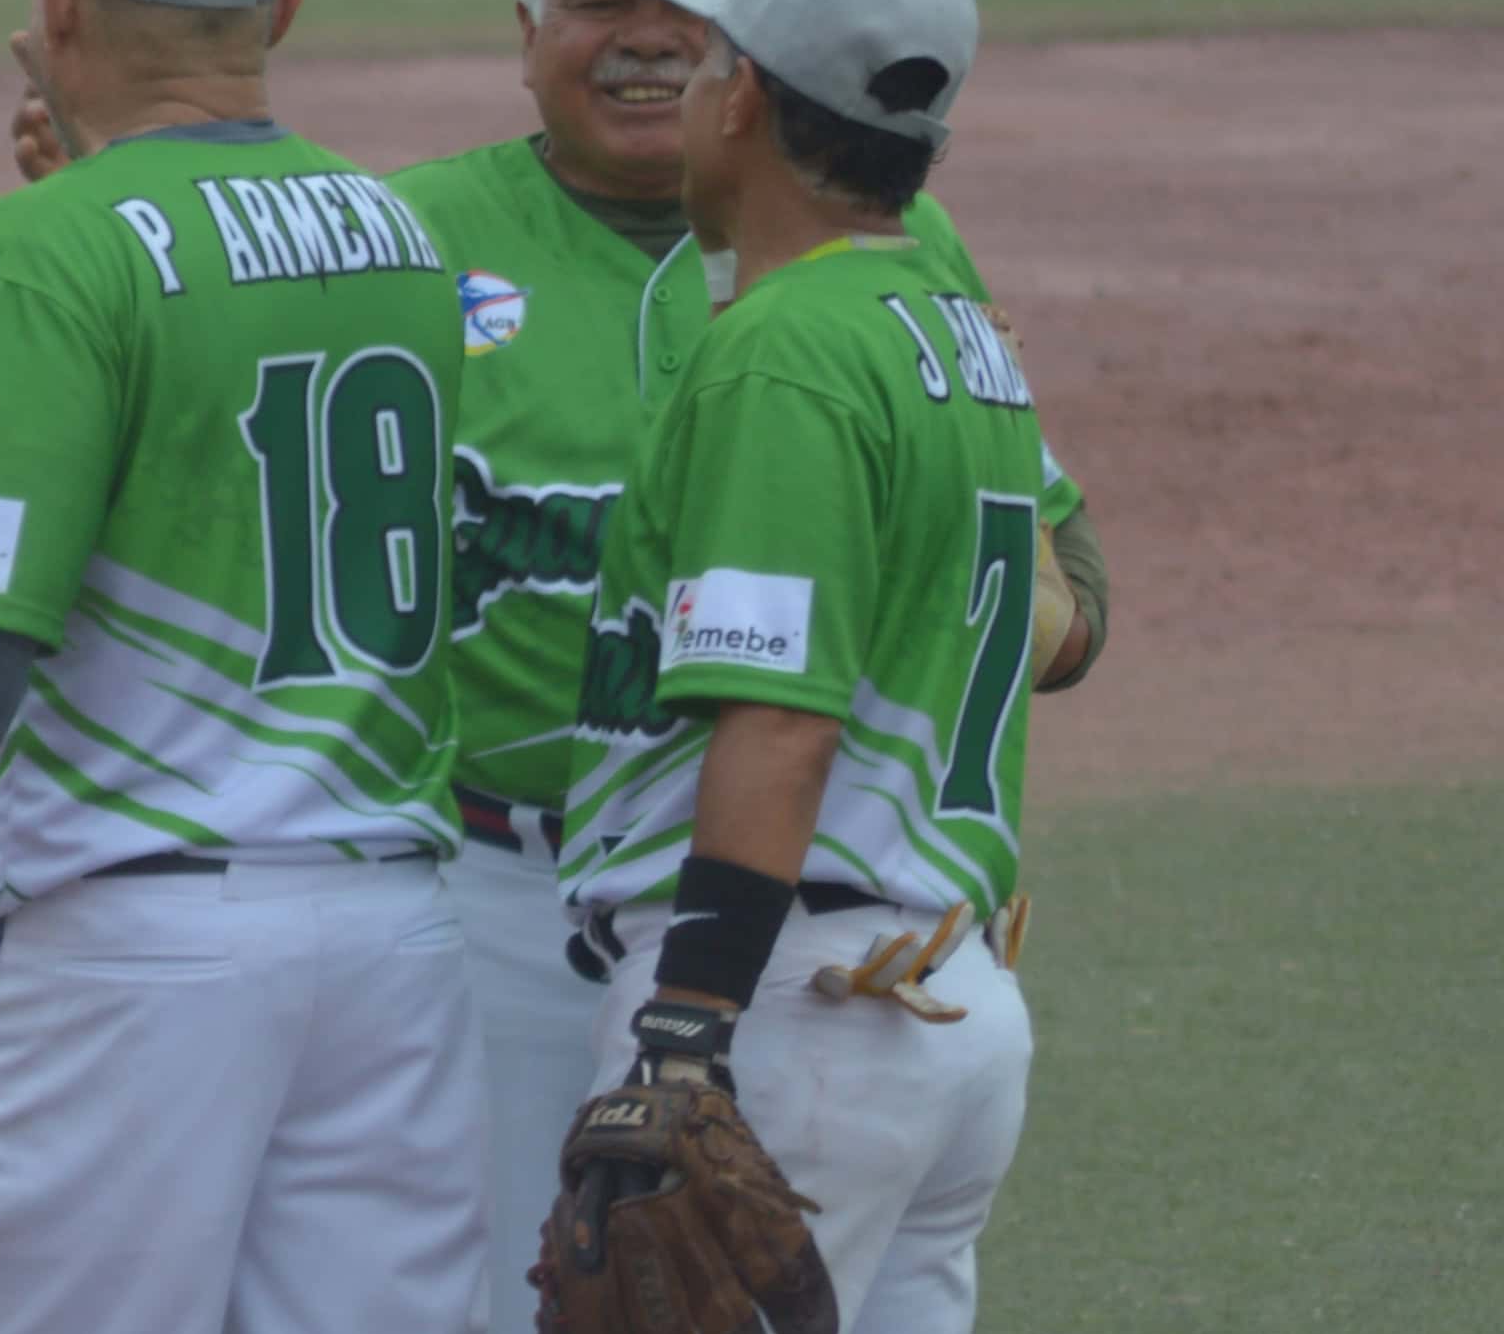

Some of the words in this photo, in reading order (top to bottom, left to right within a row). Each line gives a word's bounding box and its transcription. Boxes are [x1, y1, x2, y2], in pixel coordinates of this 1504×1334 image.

[112, 195, 186, 298] P
[877, 292, 951, 404] J
[237, 345, 442, 693] 18
[932, 488, 1037, 825] 7
